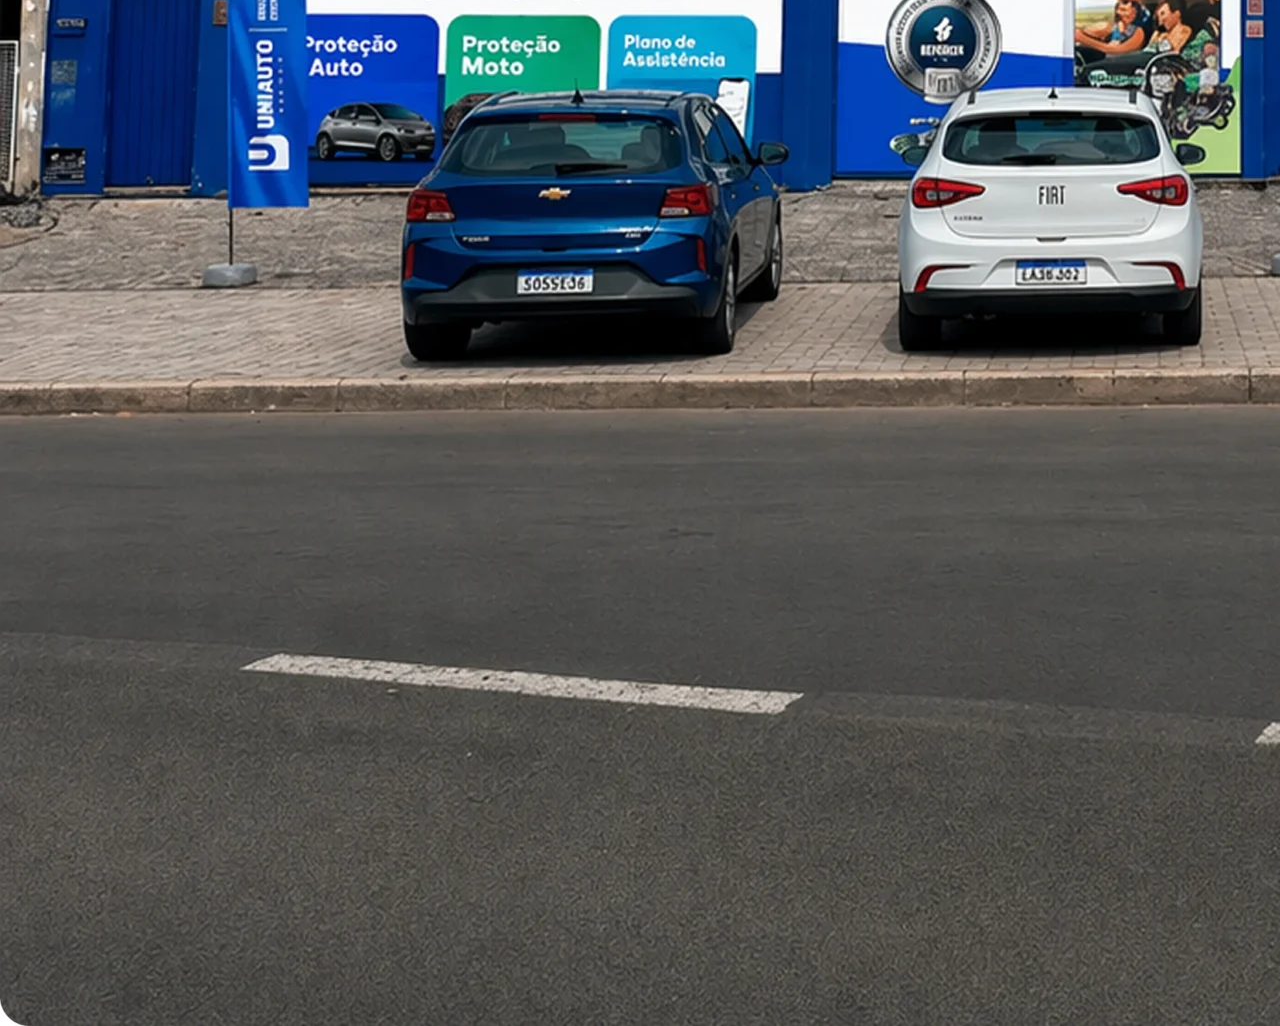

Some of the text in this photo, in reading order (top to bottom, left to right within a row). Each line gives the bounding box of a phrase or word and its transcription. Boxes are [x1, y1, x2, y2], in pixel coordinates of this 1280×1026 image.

[463, 36, 560, 59] Proteção
[625, 35, 695, 49] Plano de
[309, 58, 363, 76] Auto
[462, 56, 524, 75] Moto
[256, 40, 274, 128] UNIAUTO
[1039, 186, 1065, 204] FIAT
